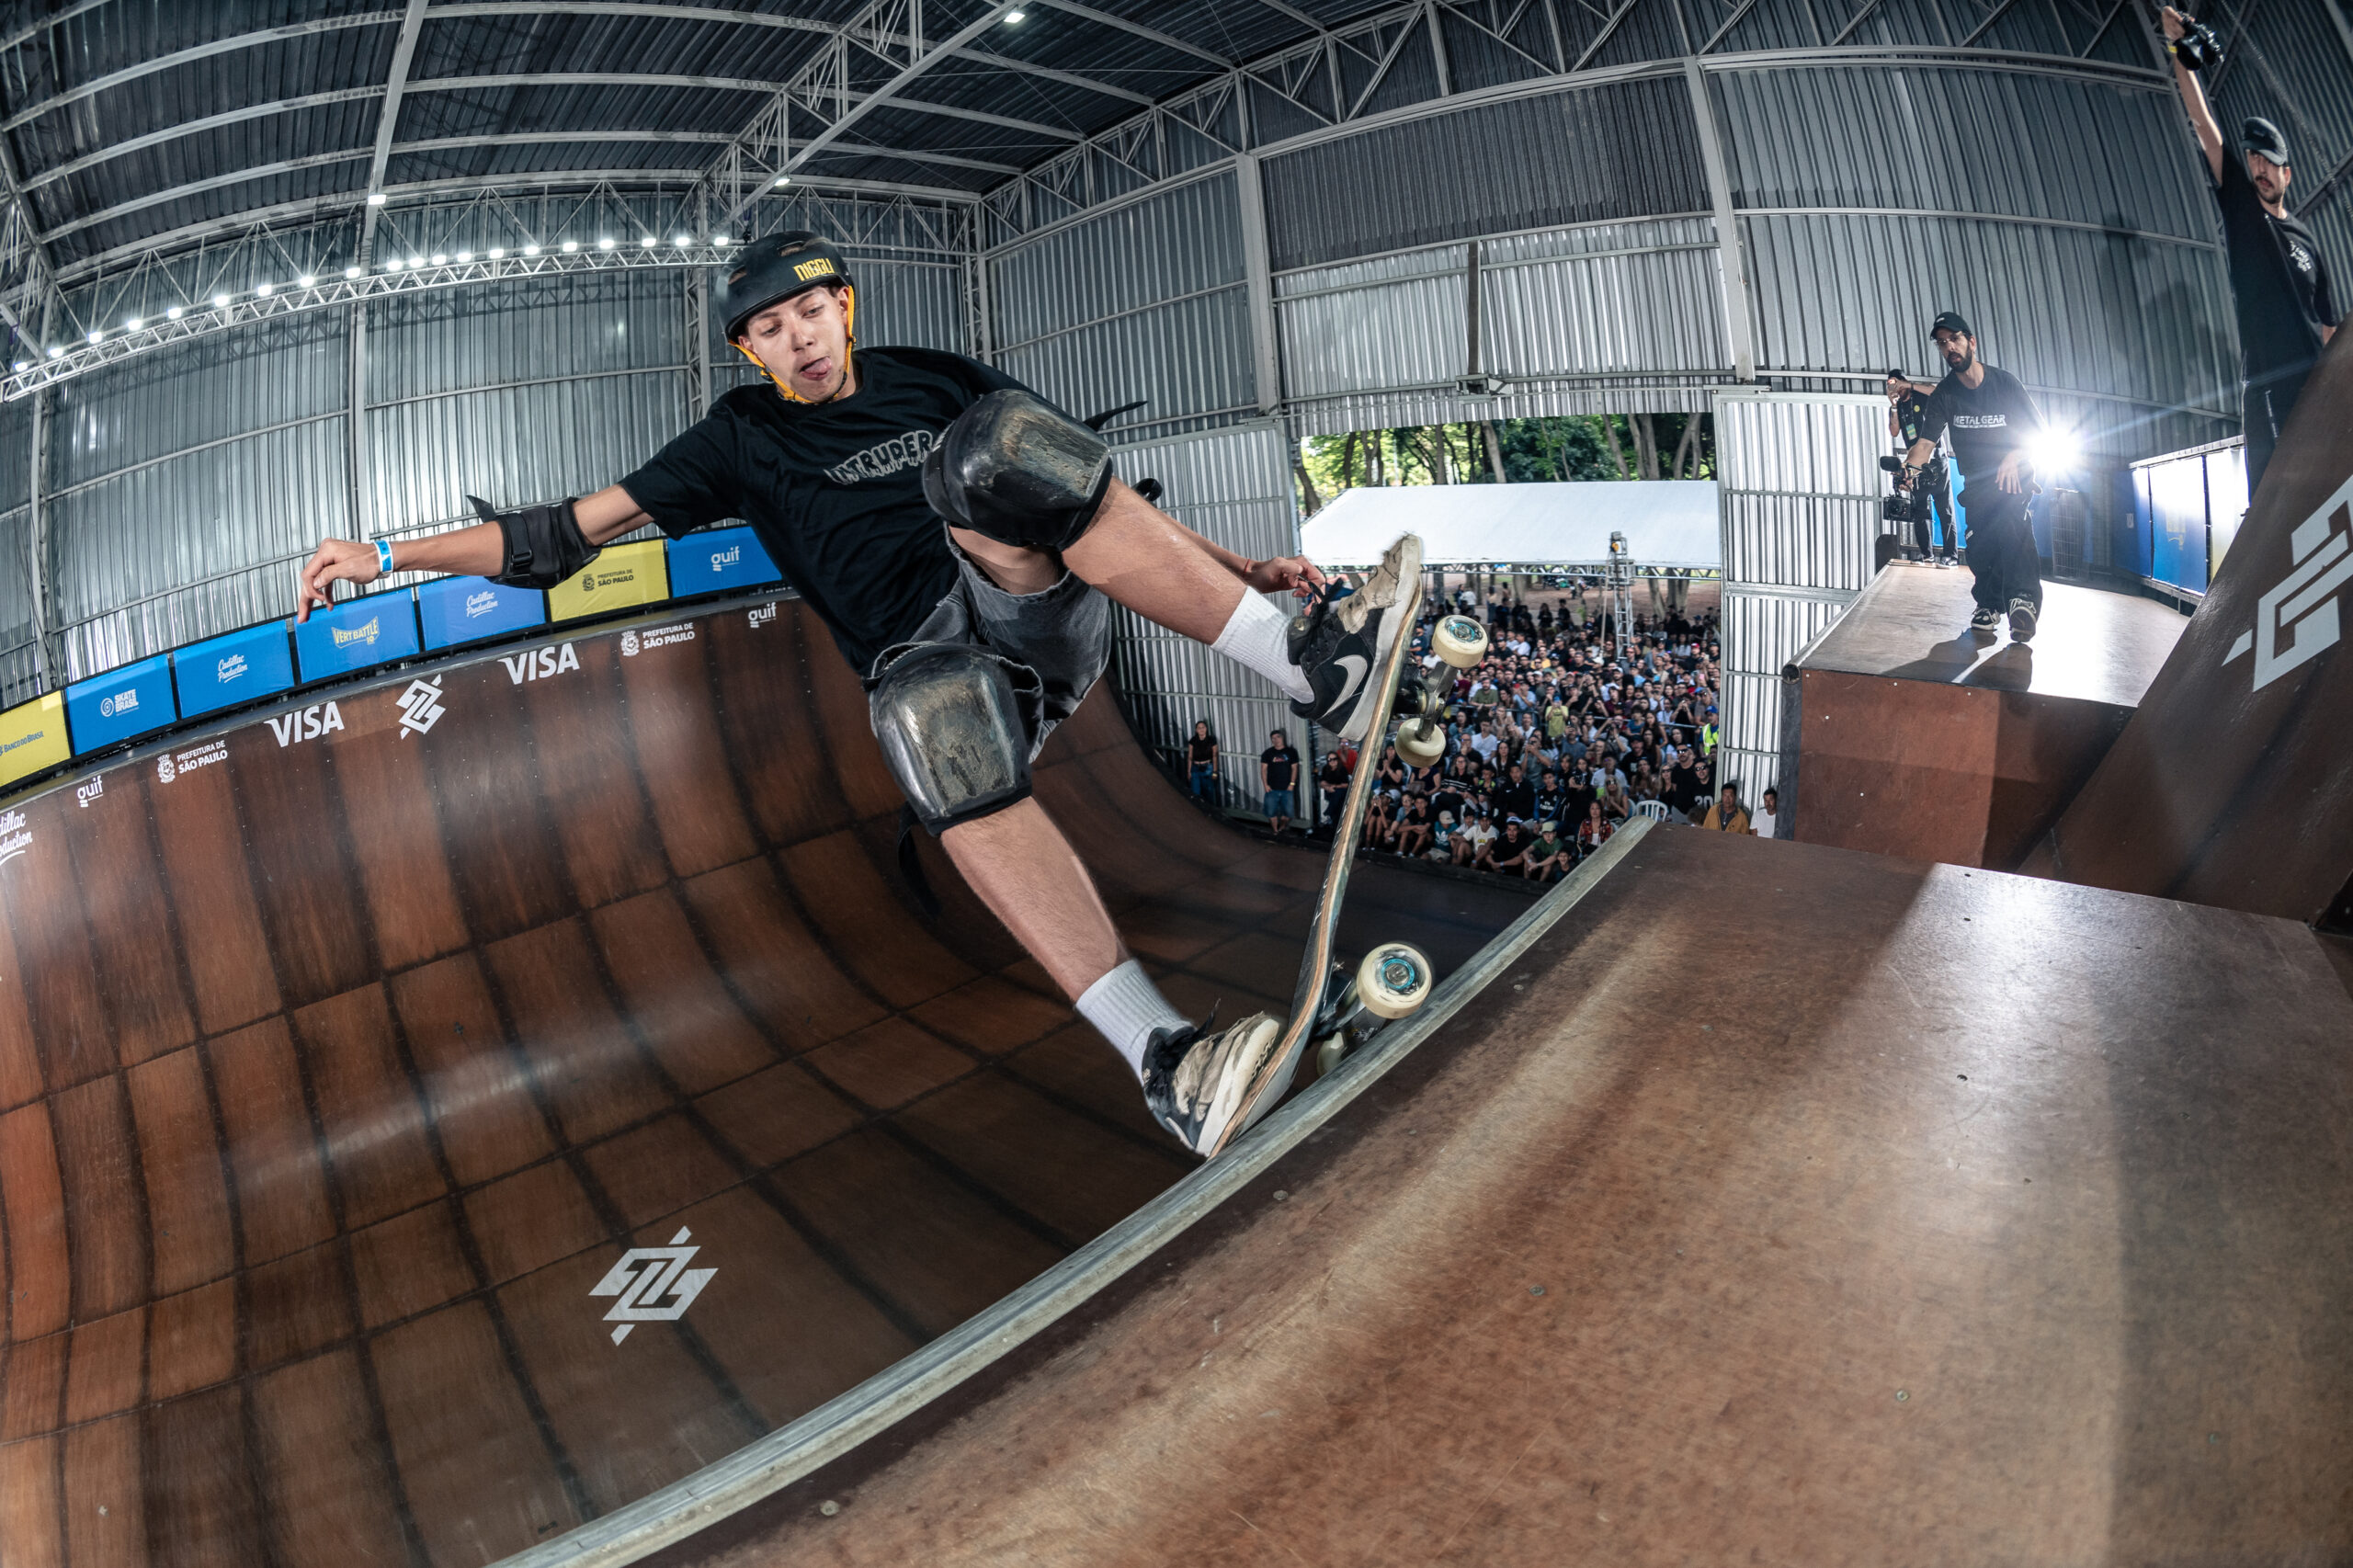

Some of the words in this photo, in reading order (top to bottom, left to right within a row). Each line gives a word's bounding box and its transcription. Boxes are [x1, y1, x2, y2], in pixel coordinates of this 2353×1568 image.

[1981, 414, 2006, 426] GEAR
[612, 574, 634, 584] PAULO
[333, 629, 354, 644] VERT
[353, 619, 379, 640] BATTLE
[642, 624, 684, 639] PREFEITURA
[683, 622, 694, 631] DE
[643, 637, 664, 650] SÃO
[664, 631, 696, 645] PAULO
[497, 642, 580, 686] VISA
[114, 688, 137, 704] SKATE
[115, 700, 140, 713] BRASIL
[263, 701, 345, 748] VISA
[176, 744, 216, 762] PREFEITURA
[215, 740, 226, 749] DE
[178, 758, 198, 774] SÃO
[198, 749, 228, 767] PAULO
